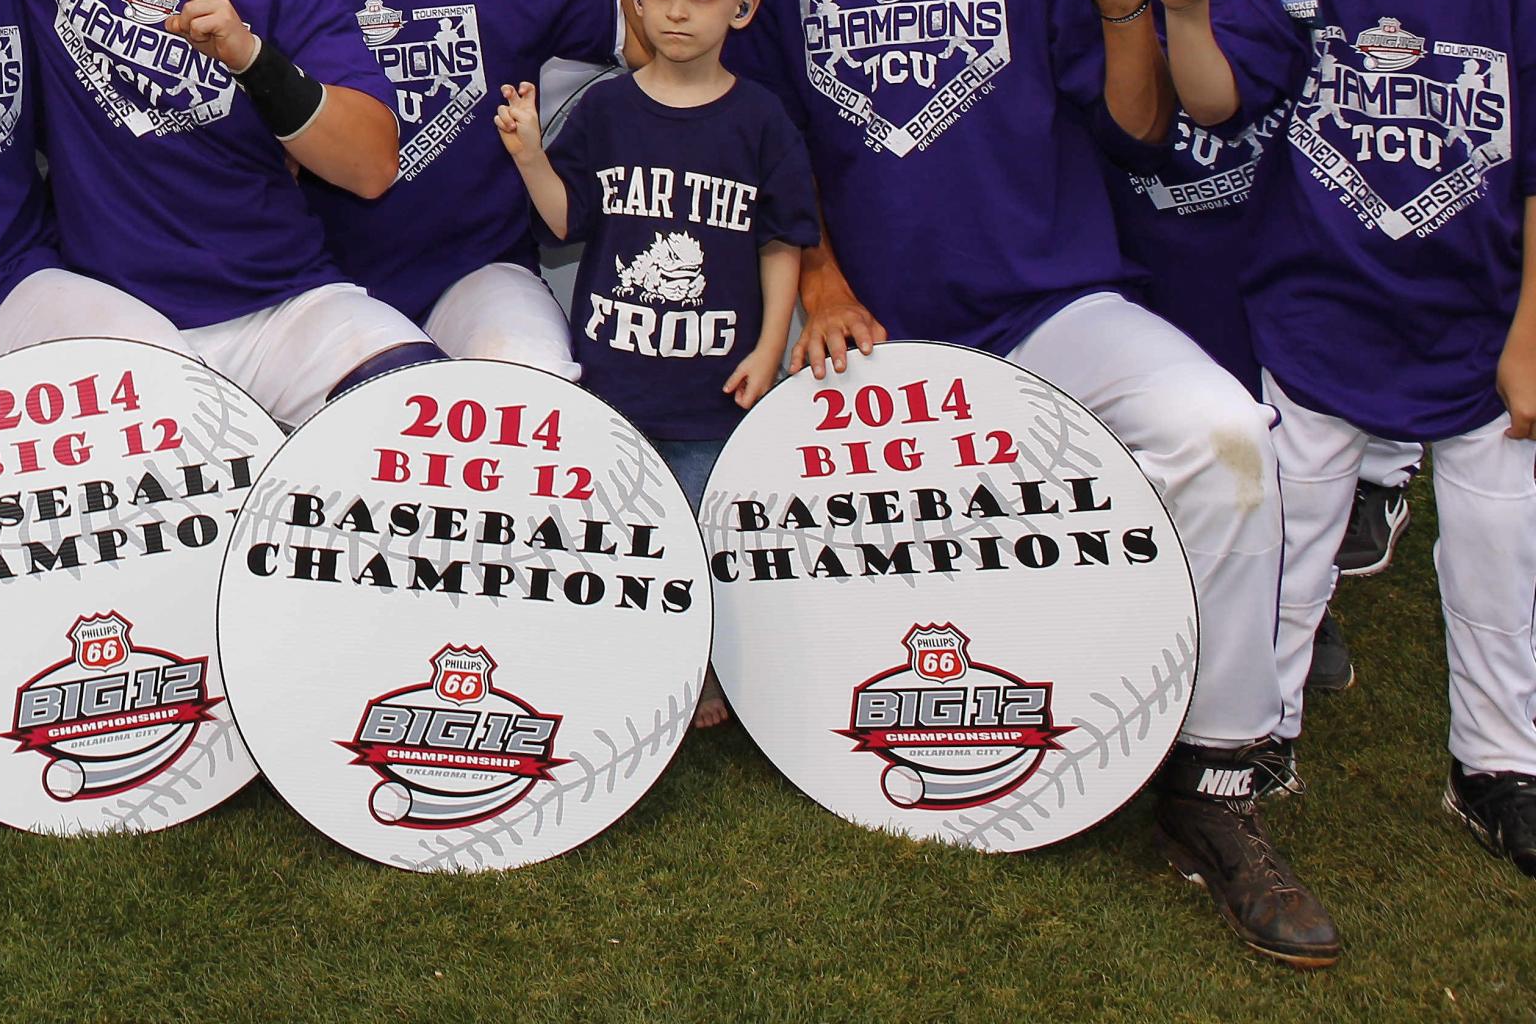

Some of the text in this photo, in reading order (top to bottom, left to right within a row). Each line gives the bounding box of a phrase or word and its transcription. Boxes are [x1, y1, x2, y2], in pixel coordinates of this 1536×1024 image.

[802, 2, 1003, 51] CHAMPIONS
[863, 50, 937, 94] TCU
[907, 53, 1004, 142] BASEBALL
[1352, 123, 1444, 170] TCU
[596, 165, 758, 232] EAR THE
[584, 292, 737, 358] FROG
[399, 394, 563, 452] 2014
[813, 377, 973, 432] 2014
[120, 417, 185, 459] 12
[795, 429, 1021, 479] BIG 12
[370, 448, 596, 501] BIG 12
[285, 492, 666, 561] BASEBALL
[732, 476, 1113, 533] BASEBALL
[710, 525, 1160, 584] CHAMPIONS
[246, 542, 695, 614] CHAMPIONS
[80, 625, 118, 640] PHILLIPS
[85, 640, 117, 663] 66
[917, 637, 955, 650] PHILLIPS
[444, 658, 483, 673] PHILLIPS
[923, 651, 956, 674] 66
[19, 666, 201, 728] BIG 12
[444, 674, 478, 696] 66
[855, 687, 1047, 727] BIG 12
[47, 708, 180, 736] CHAMPIONSHIP
[70, 727, 161, 749] OKLAHOMA CITY
[360, 707, 556, 755] BIG 12
[884, 731, 1024, 744] CHAMPIONSHIP
[386, 749, 522, 769] CHAMPIONSHIP
[908, 747, 1004, 757] OKLAHOMA CITY
[405, 767, 499, 782] OKLAHOMA CITY
[1196, 768, 1254, 797] NIKE
